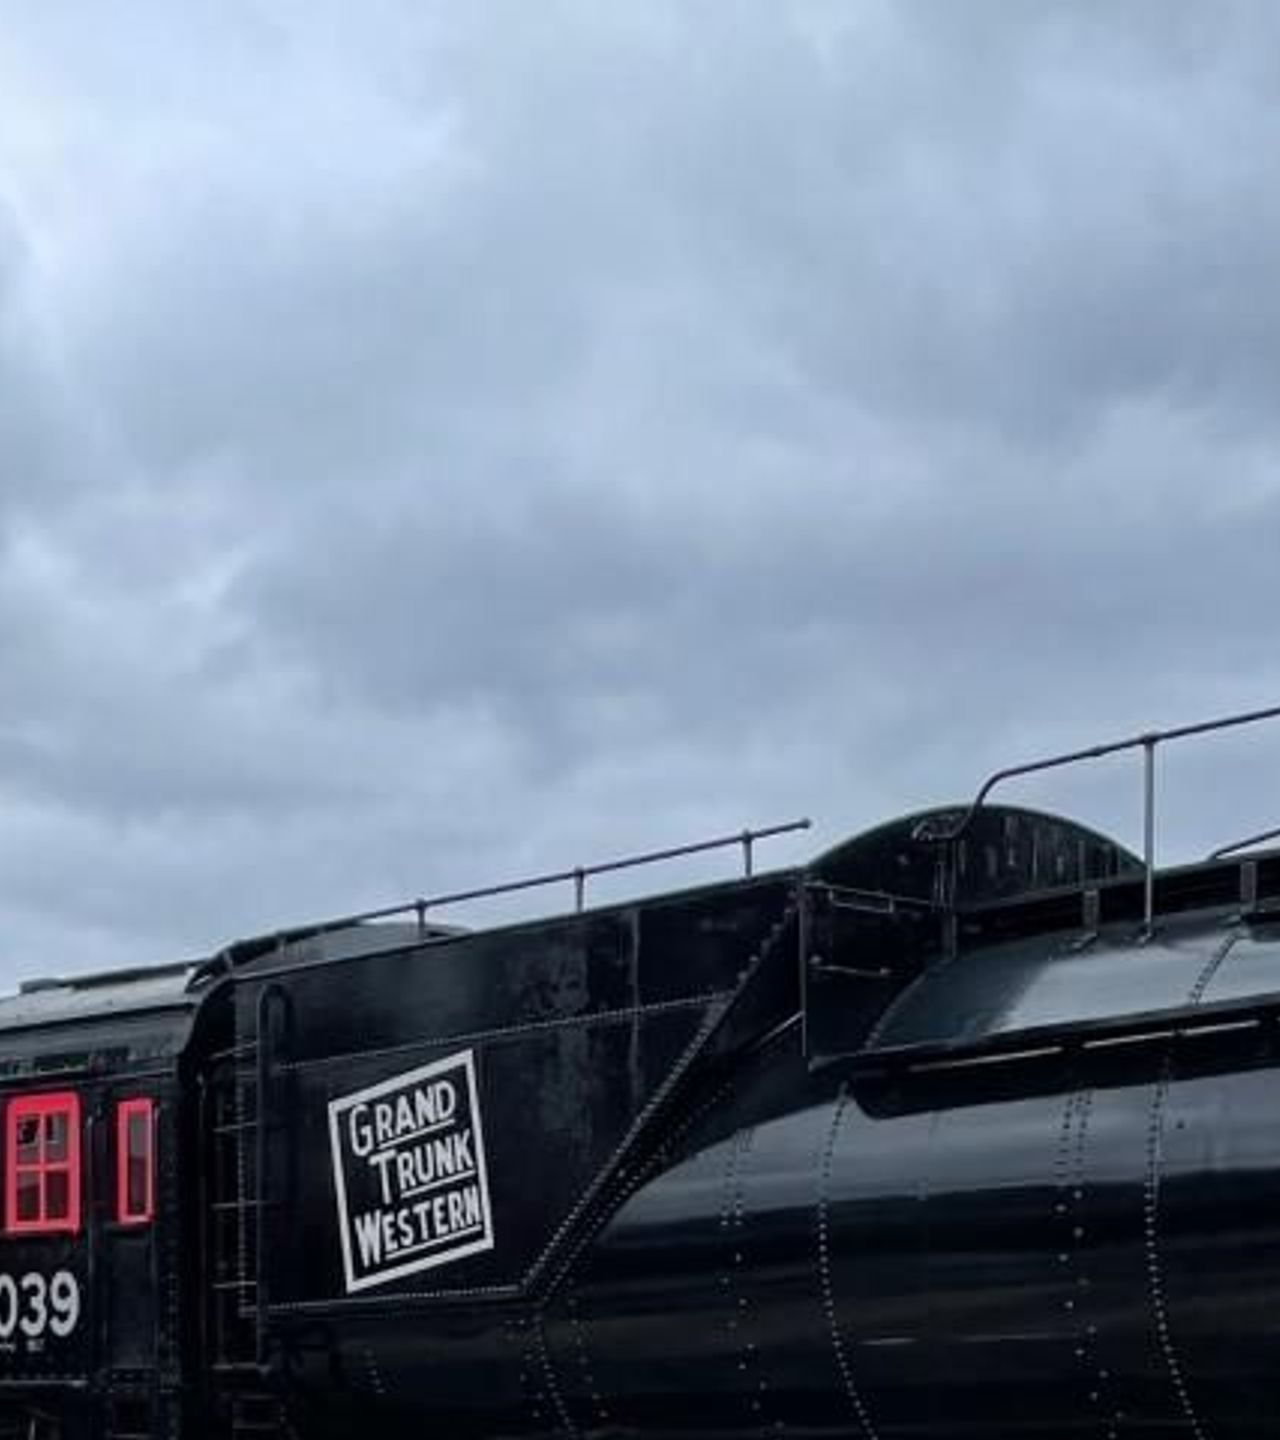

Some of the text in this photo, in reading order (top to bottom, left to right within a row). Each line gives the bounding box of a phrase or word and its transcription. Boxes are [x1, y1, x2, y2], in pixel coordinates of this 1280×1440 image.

[349, 1080, 456, 1157] GRAND
[369, 1129, 474, 1204] TRUNK
[354, 1184, 481, 1267] WESTERN
